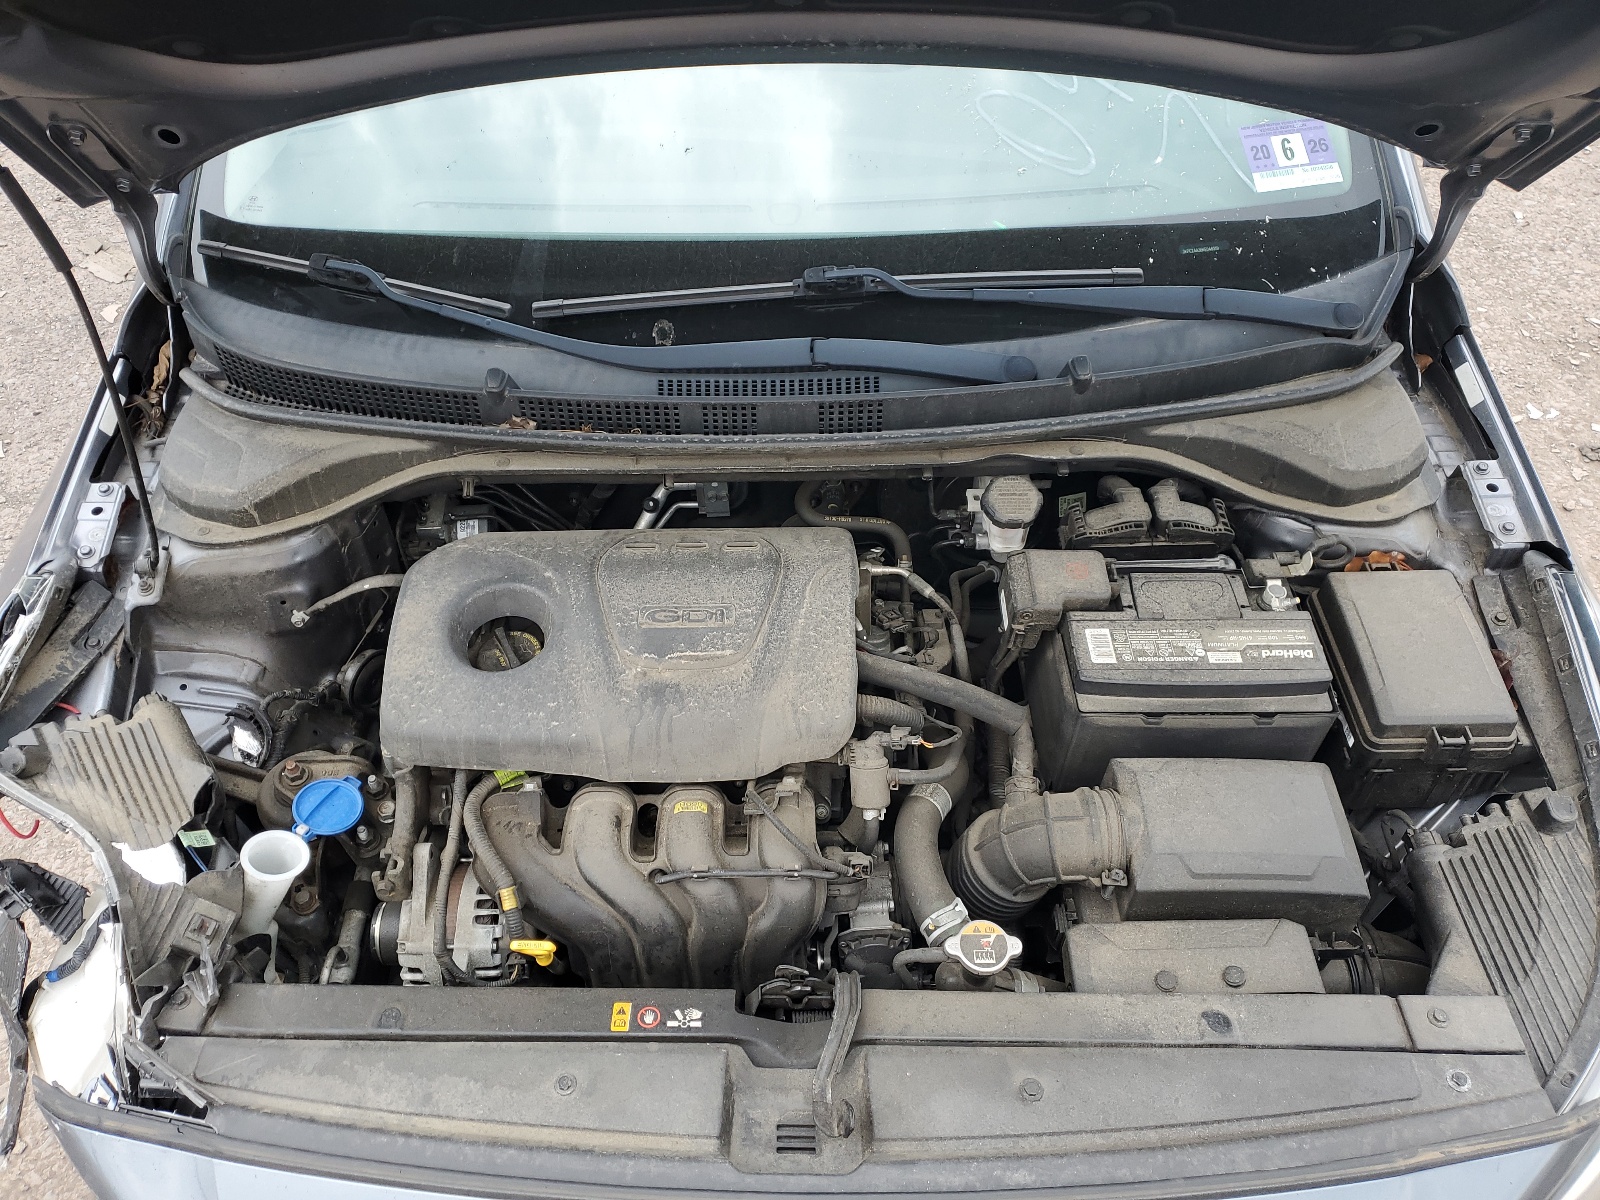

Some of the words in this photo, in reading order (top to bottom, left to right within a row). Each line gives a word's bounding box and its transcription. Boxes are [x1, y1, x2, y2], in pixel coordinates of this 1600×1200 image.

[1250, 144, 1271, 161] 20
[1280, 137, 1295, 161] 6
[1308, 138, 1329, 154] 26
[1261, 649, 1314, 659] DieHard
